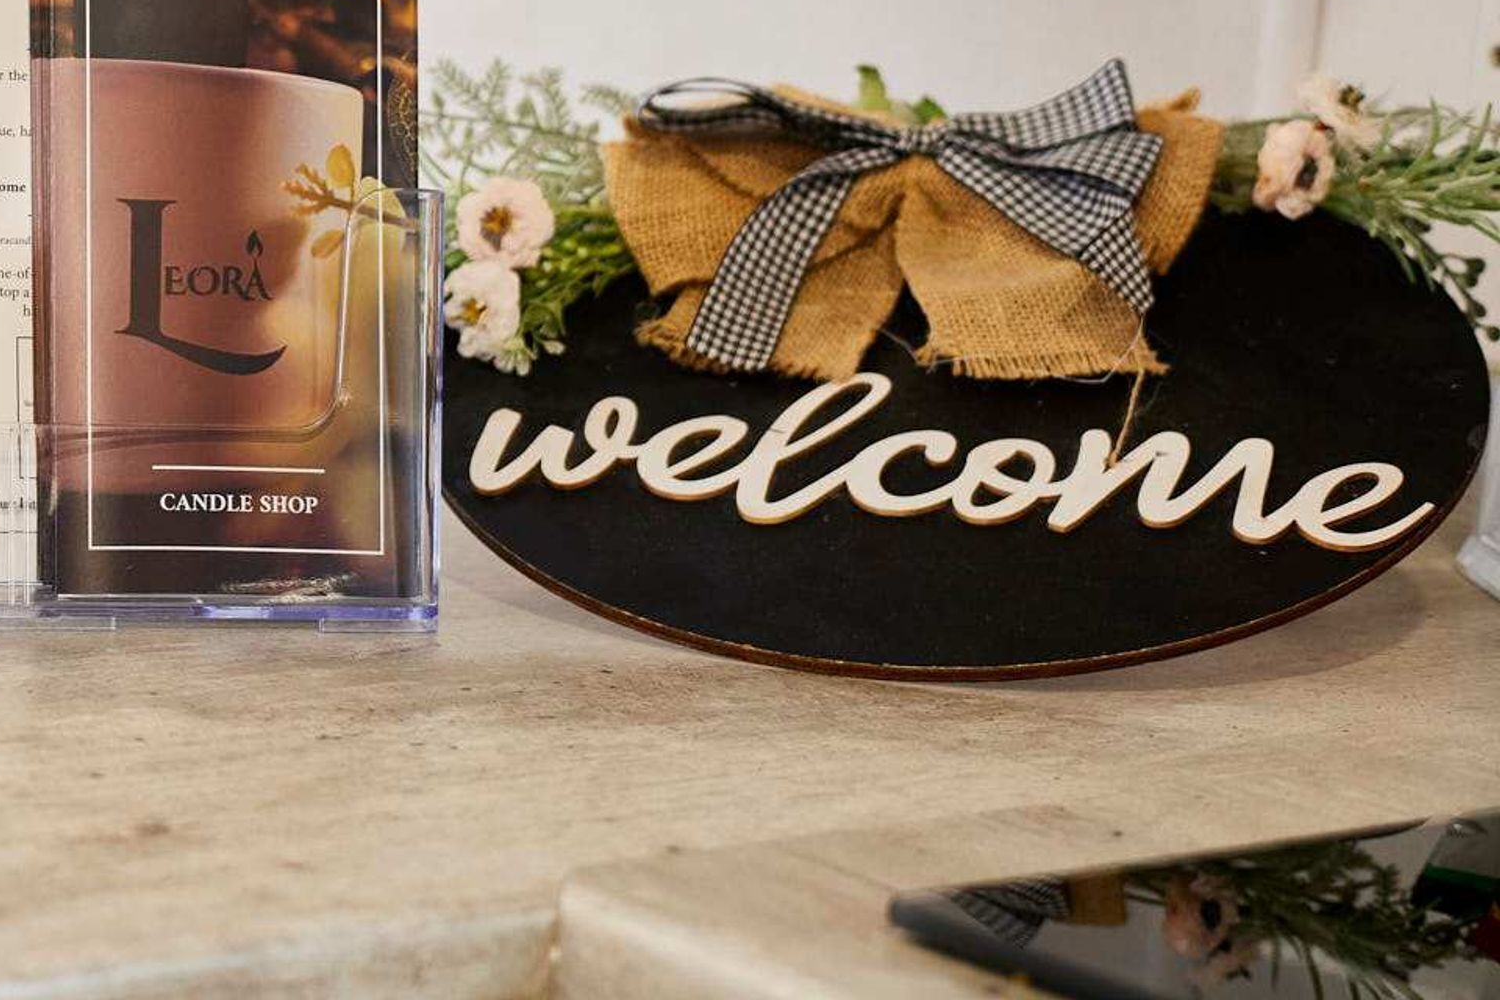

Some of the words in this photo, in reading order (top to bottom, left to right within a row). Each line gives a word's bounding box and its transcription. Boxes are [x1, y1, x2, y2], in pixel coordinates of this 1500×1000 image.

[9, 69, 28, 81] the
[468, 371, 1434, 549] welcome
[160, 493, 253, 513] CANDLE
[259, 495, 319, 514] SHOP
